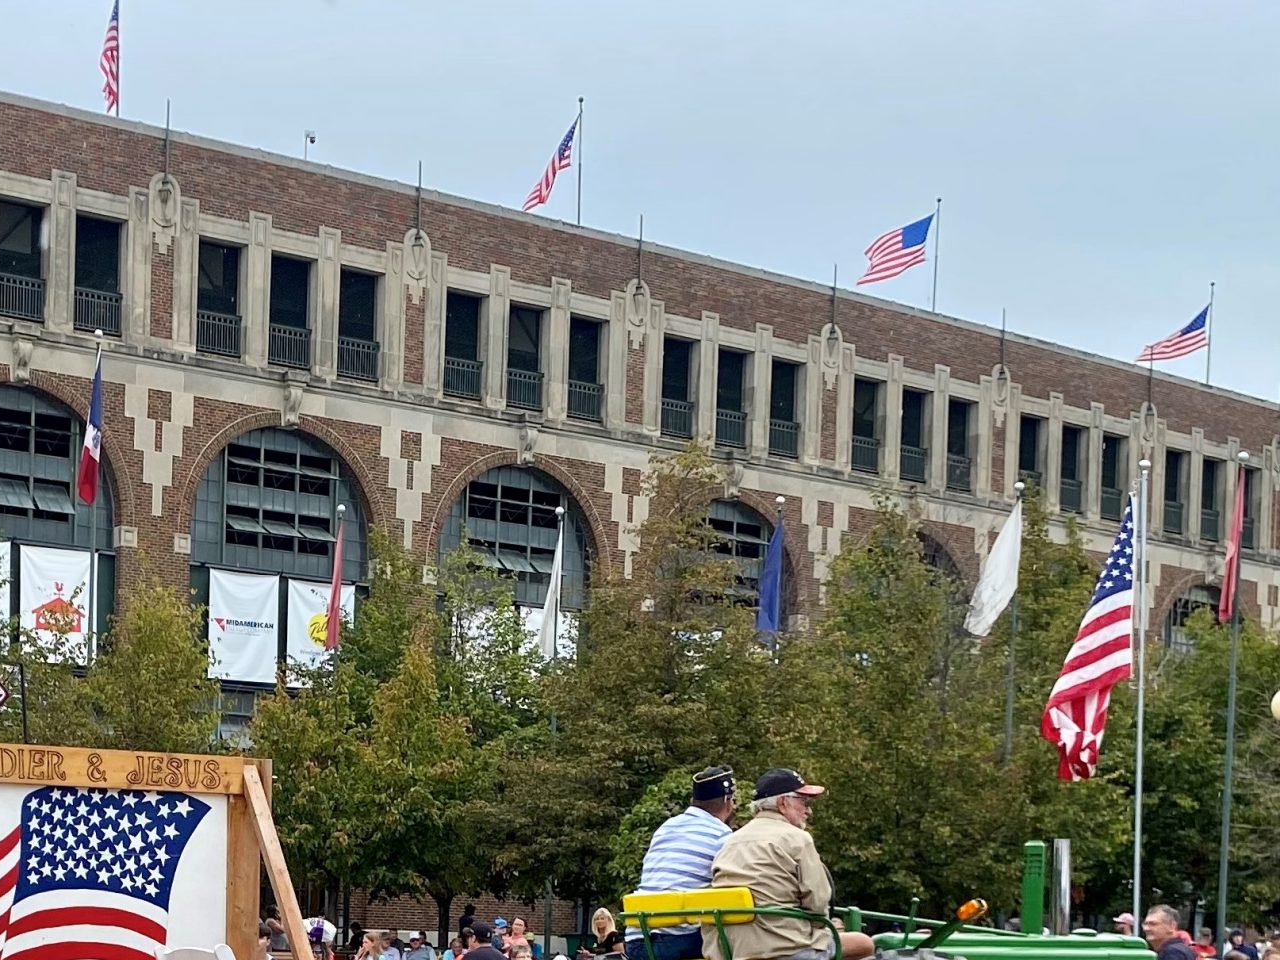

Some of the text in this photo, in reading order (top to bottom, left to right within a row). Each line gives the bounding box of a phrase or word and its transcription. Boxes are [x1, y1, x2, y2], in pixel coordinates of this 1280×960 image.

[226, 618, 274, 630] MIDAMERICAN
[86, 752, 108, 783] &
[126, 755, 221, 790] JESUS
